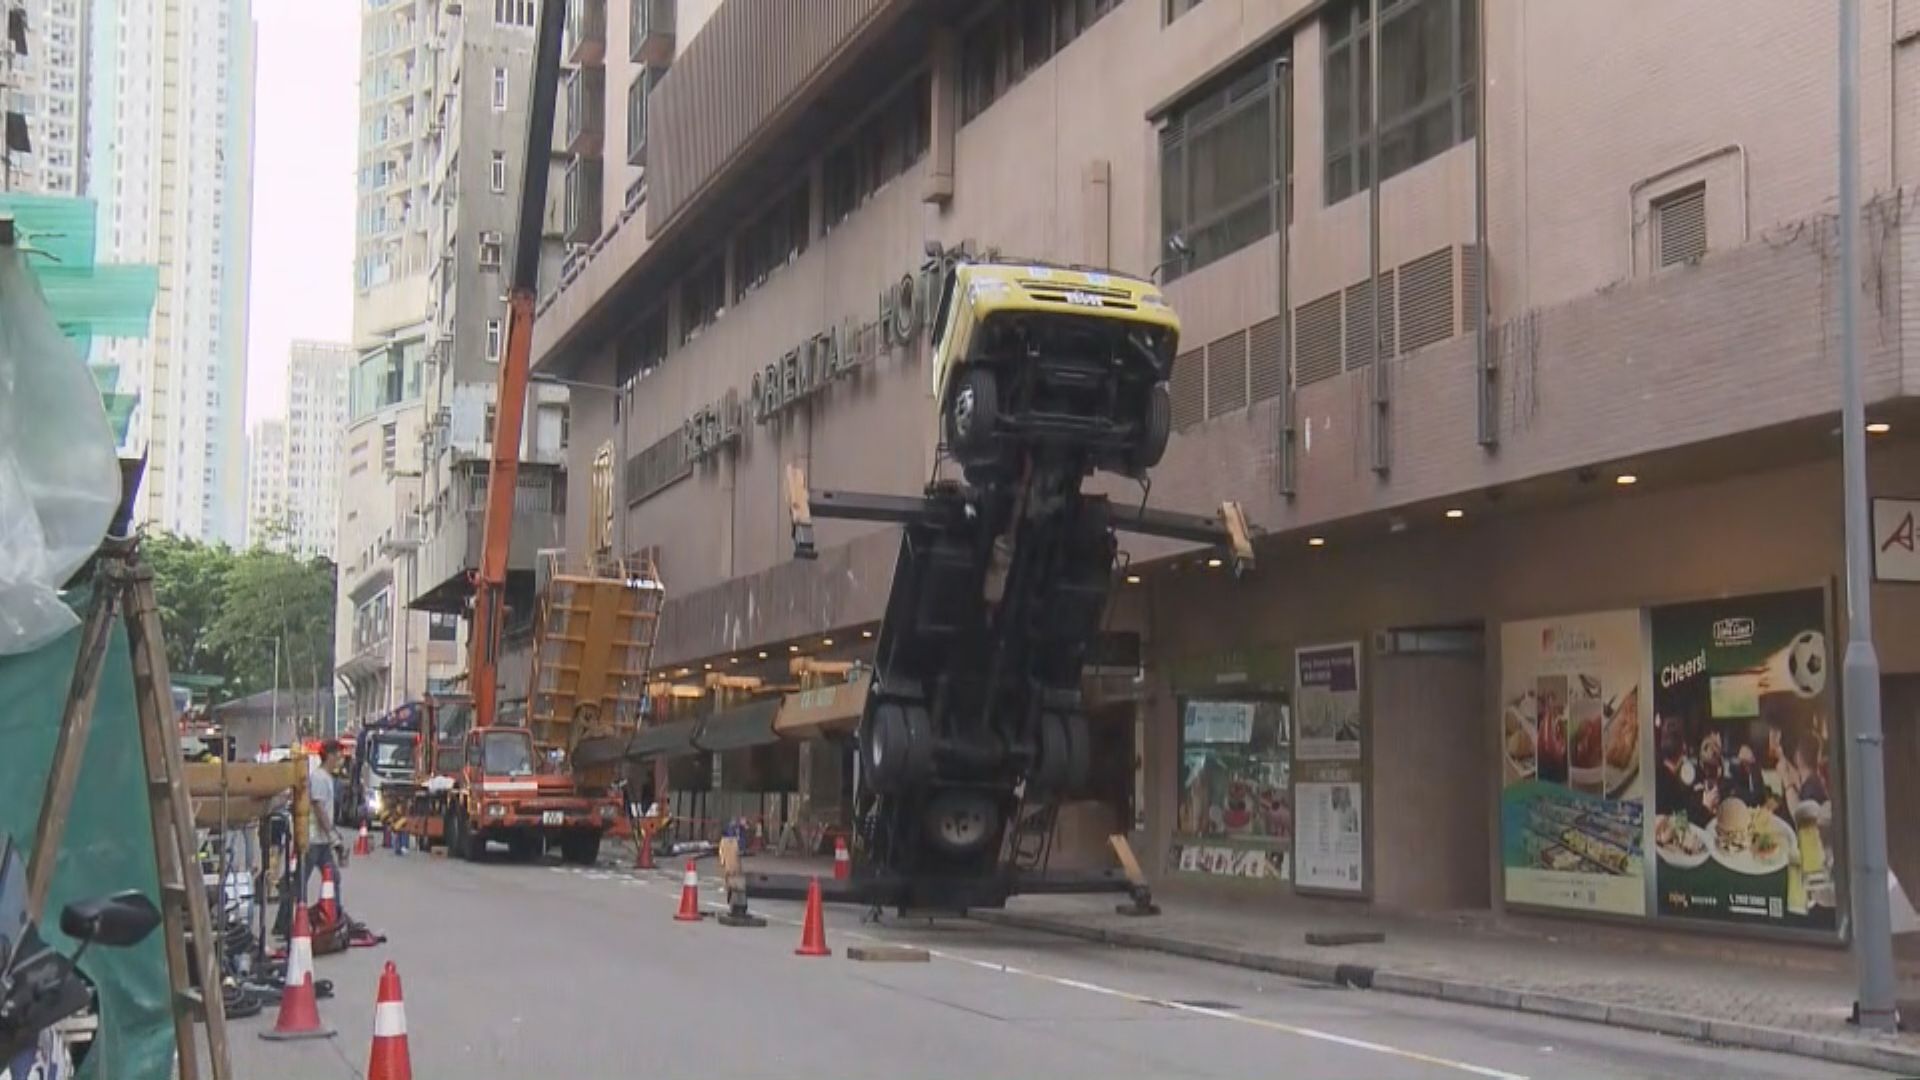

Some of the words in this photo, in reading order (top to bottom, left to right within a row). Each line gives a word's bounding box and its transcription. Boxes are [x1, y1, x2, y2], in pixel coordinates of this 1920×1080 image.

[751, 317, 855, 418] ORIENTAL
[879, 259, 942, 341] HOT
[1660, 648, 1707, 690] Cheers!
